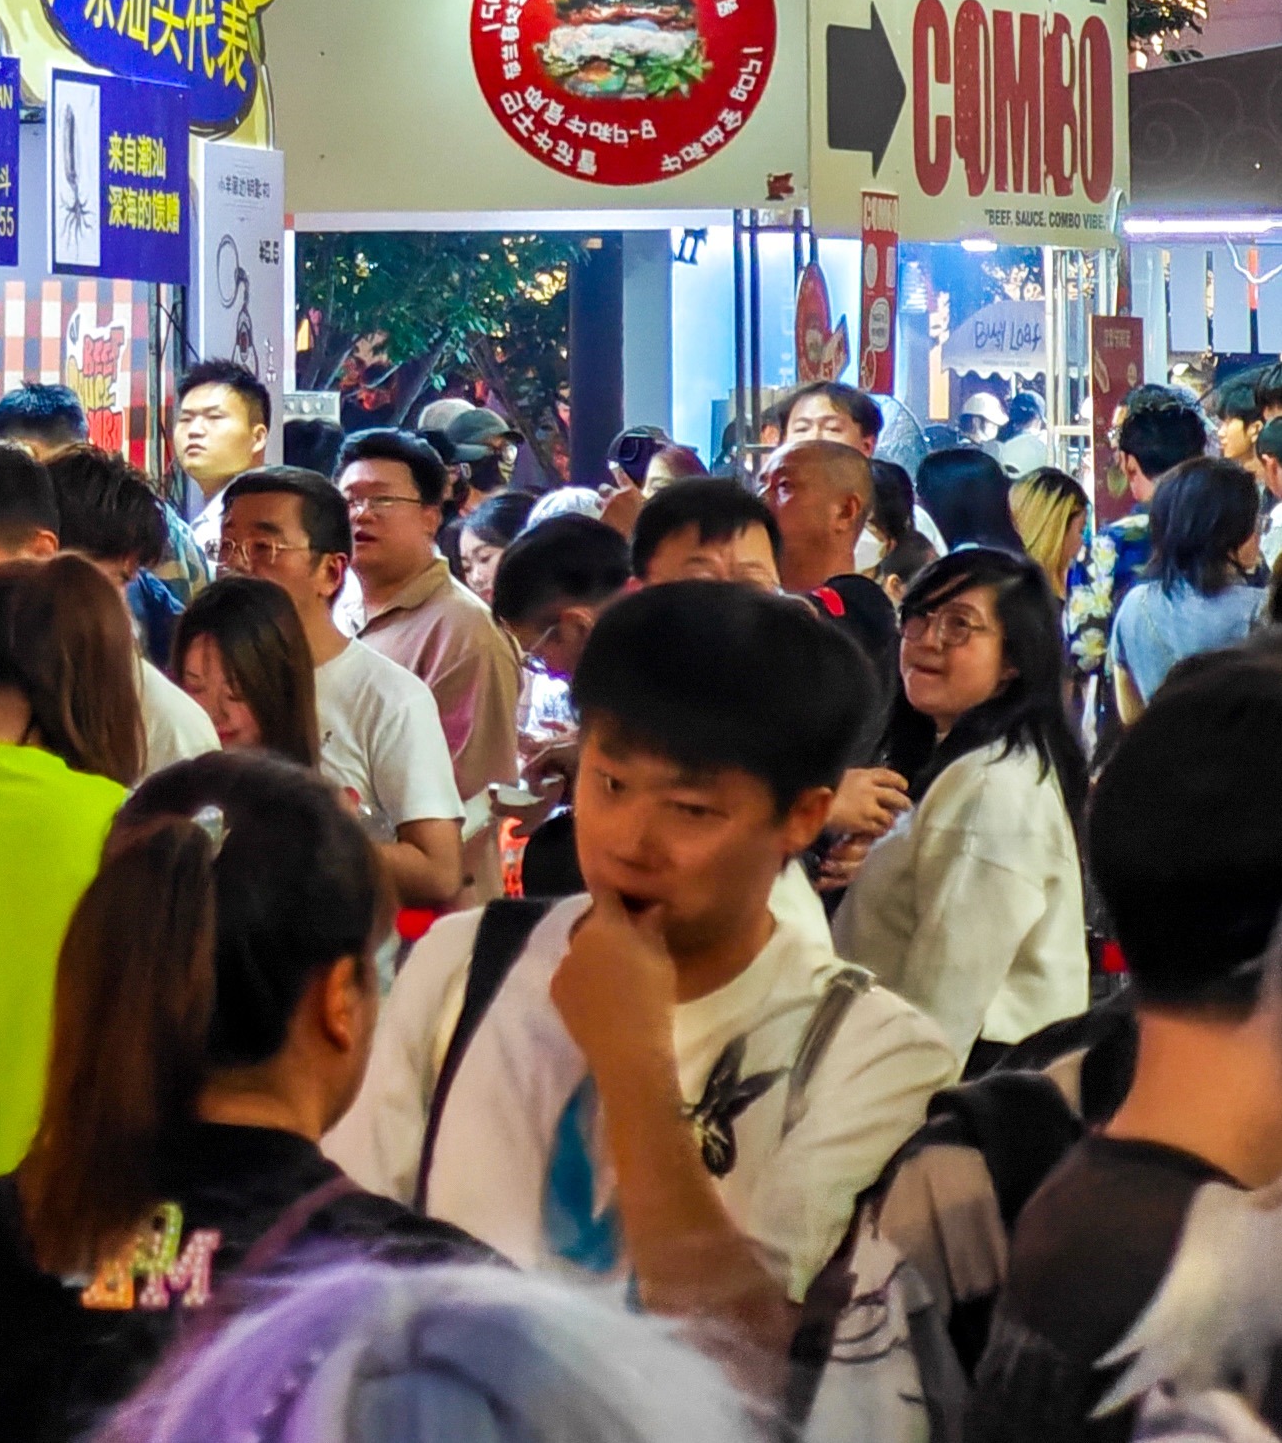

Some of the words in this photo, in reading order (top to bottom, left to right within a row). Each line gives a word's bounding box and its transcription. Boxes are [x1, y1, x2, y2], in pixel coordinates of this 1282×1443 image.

[107, 130, 167, 181] 来自潮汕
[107, 184, 181, 236] 深海的馈赠
[1048, 211, 1081, 230] COMBO
